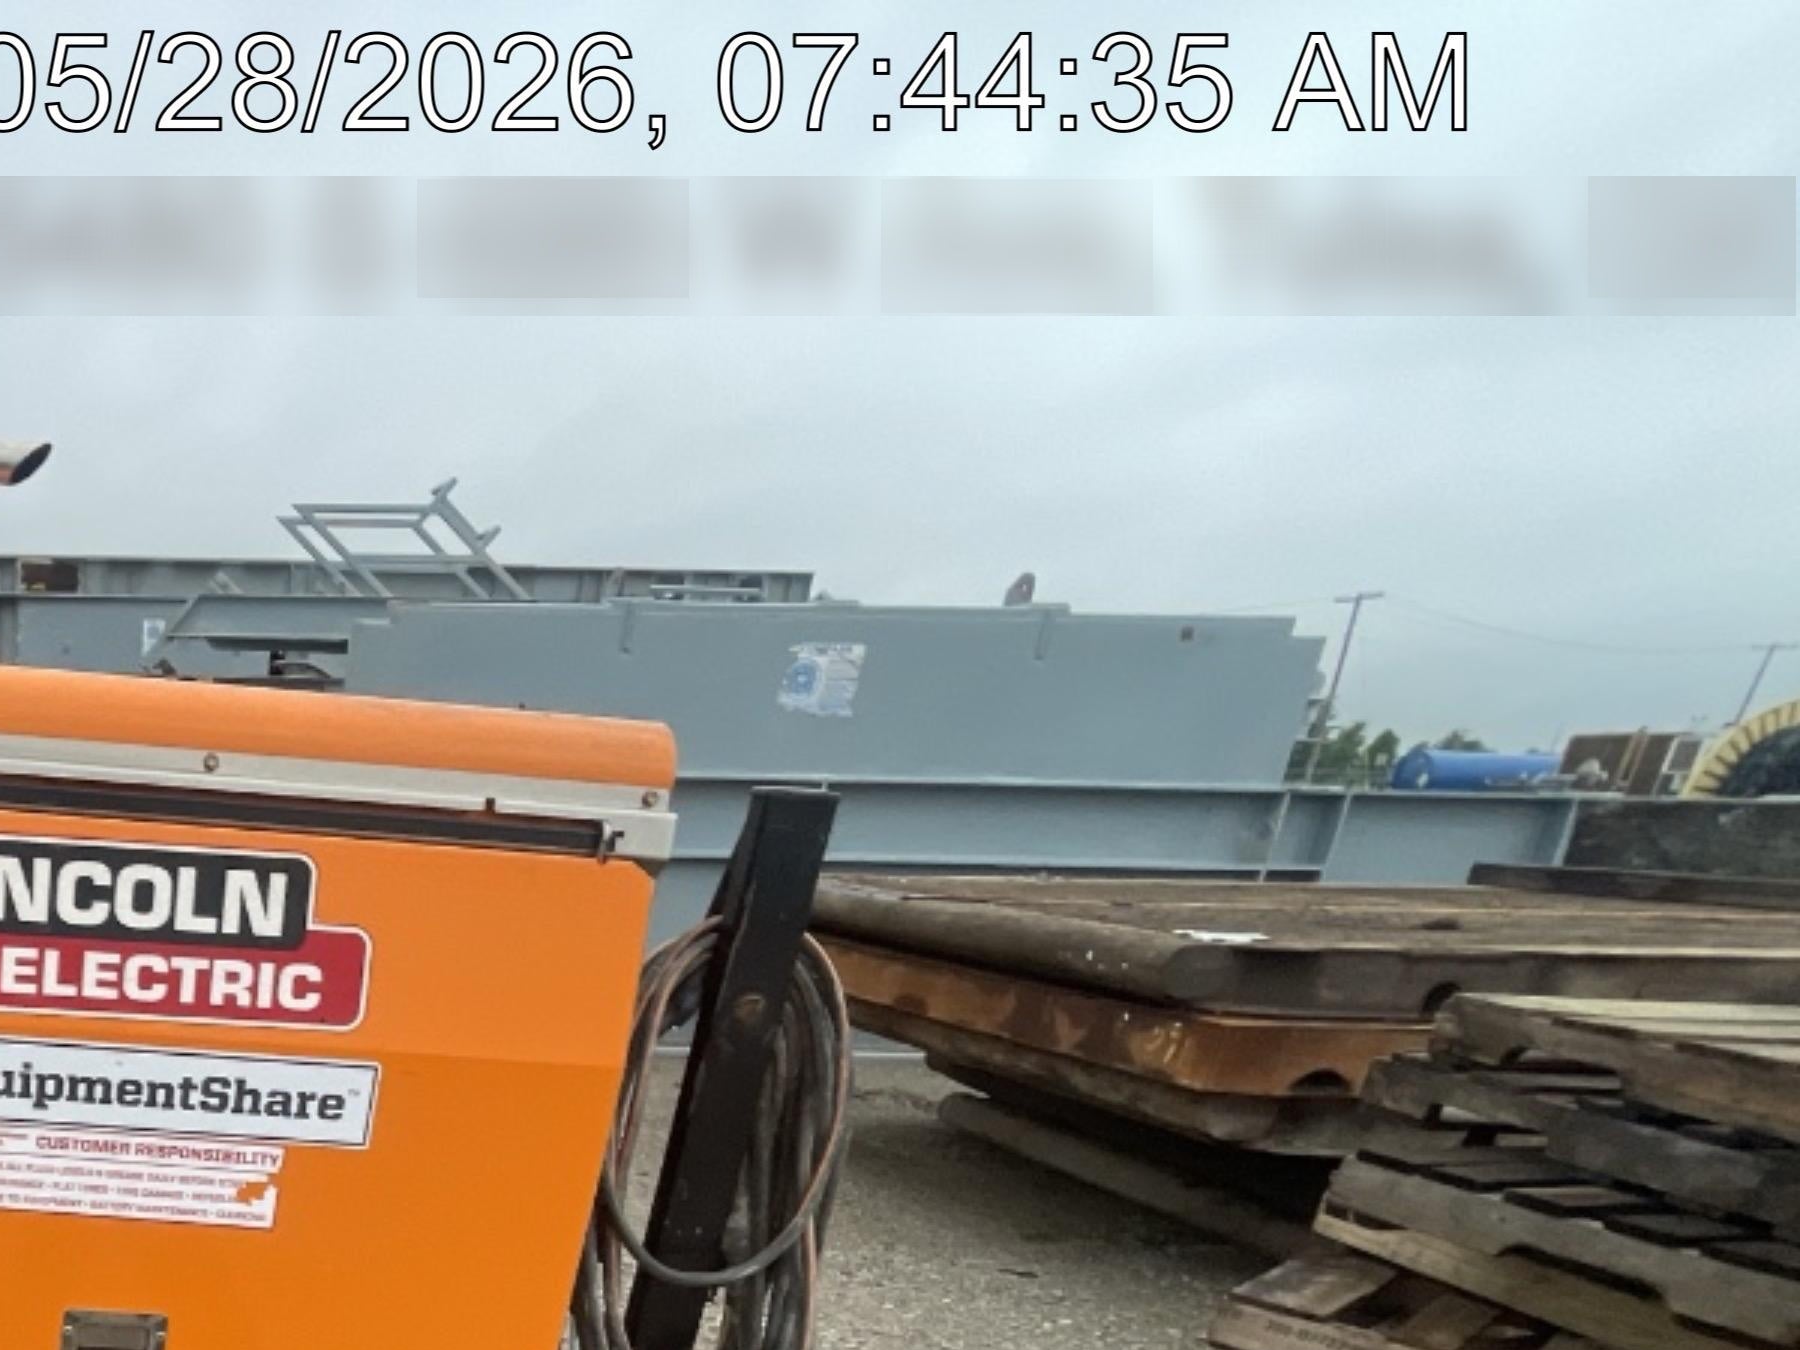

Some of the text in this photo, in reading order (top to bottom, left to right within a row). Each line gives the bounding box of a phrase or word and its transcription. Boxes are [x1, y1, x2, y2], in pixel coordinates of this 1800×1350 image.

[0, 945, 324, 1012] ELECTRIC
[35, 1135, 130, 1156] CUSTOMER
[134, 1141, 280, 1168] RESPONSIBILITY
